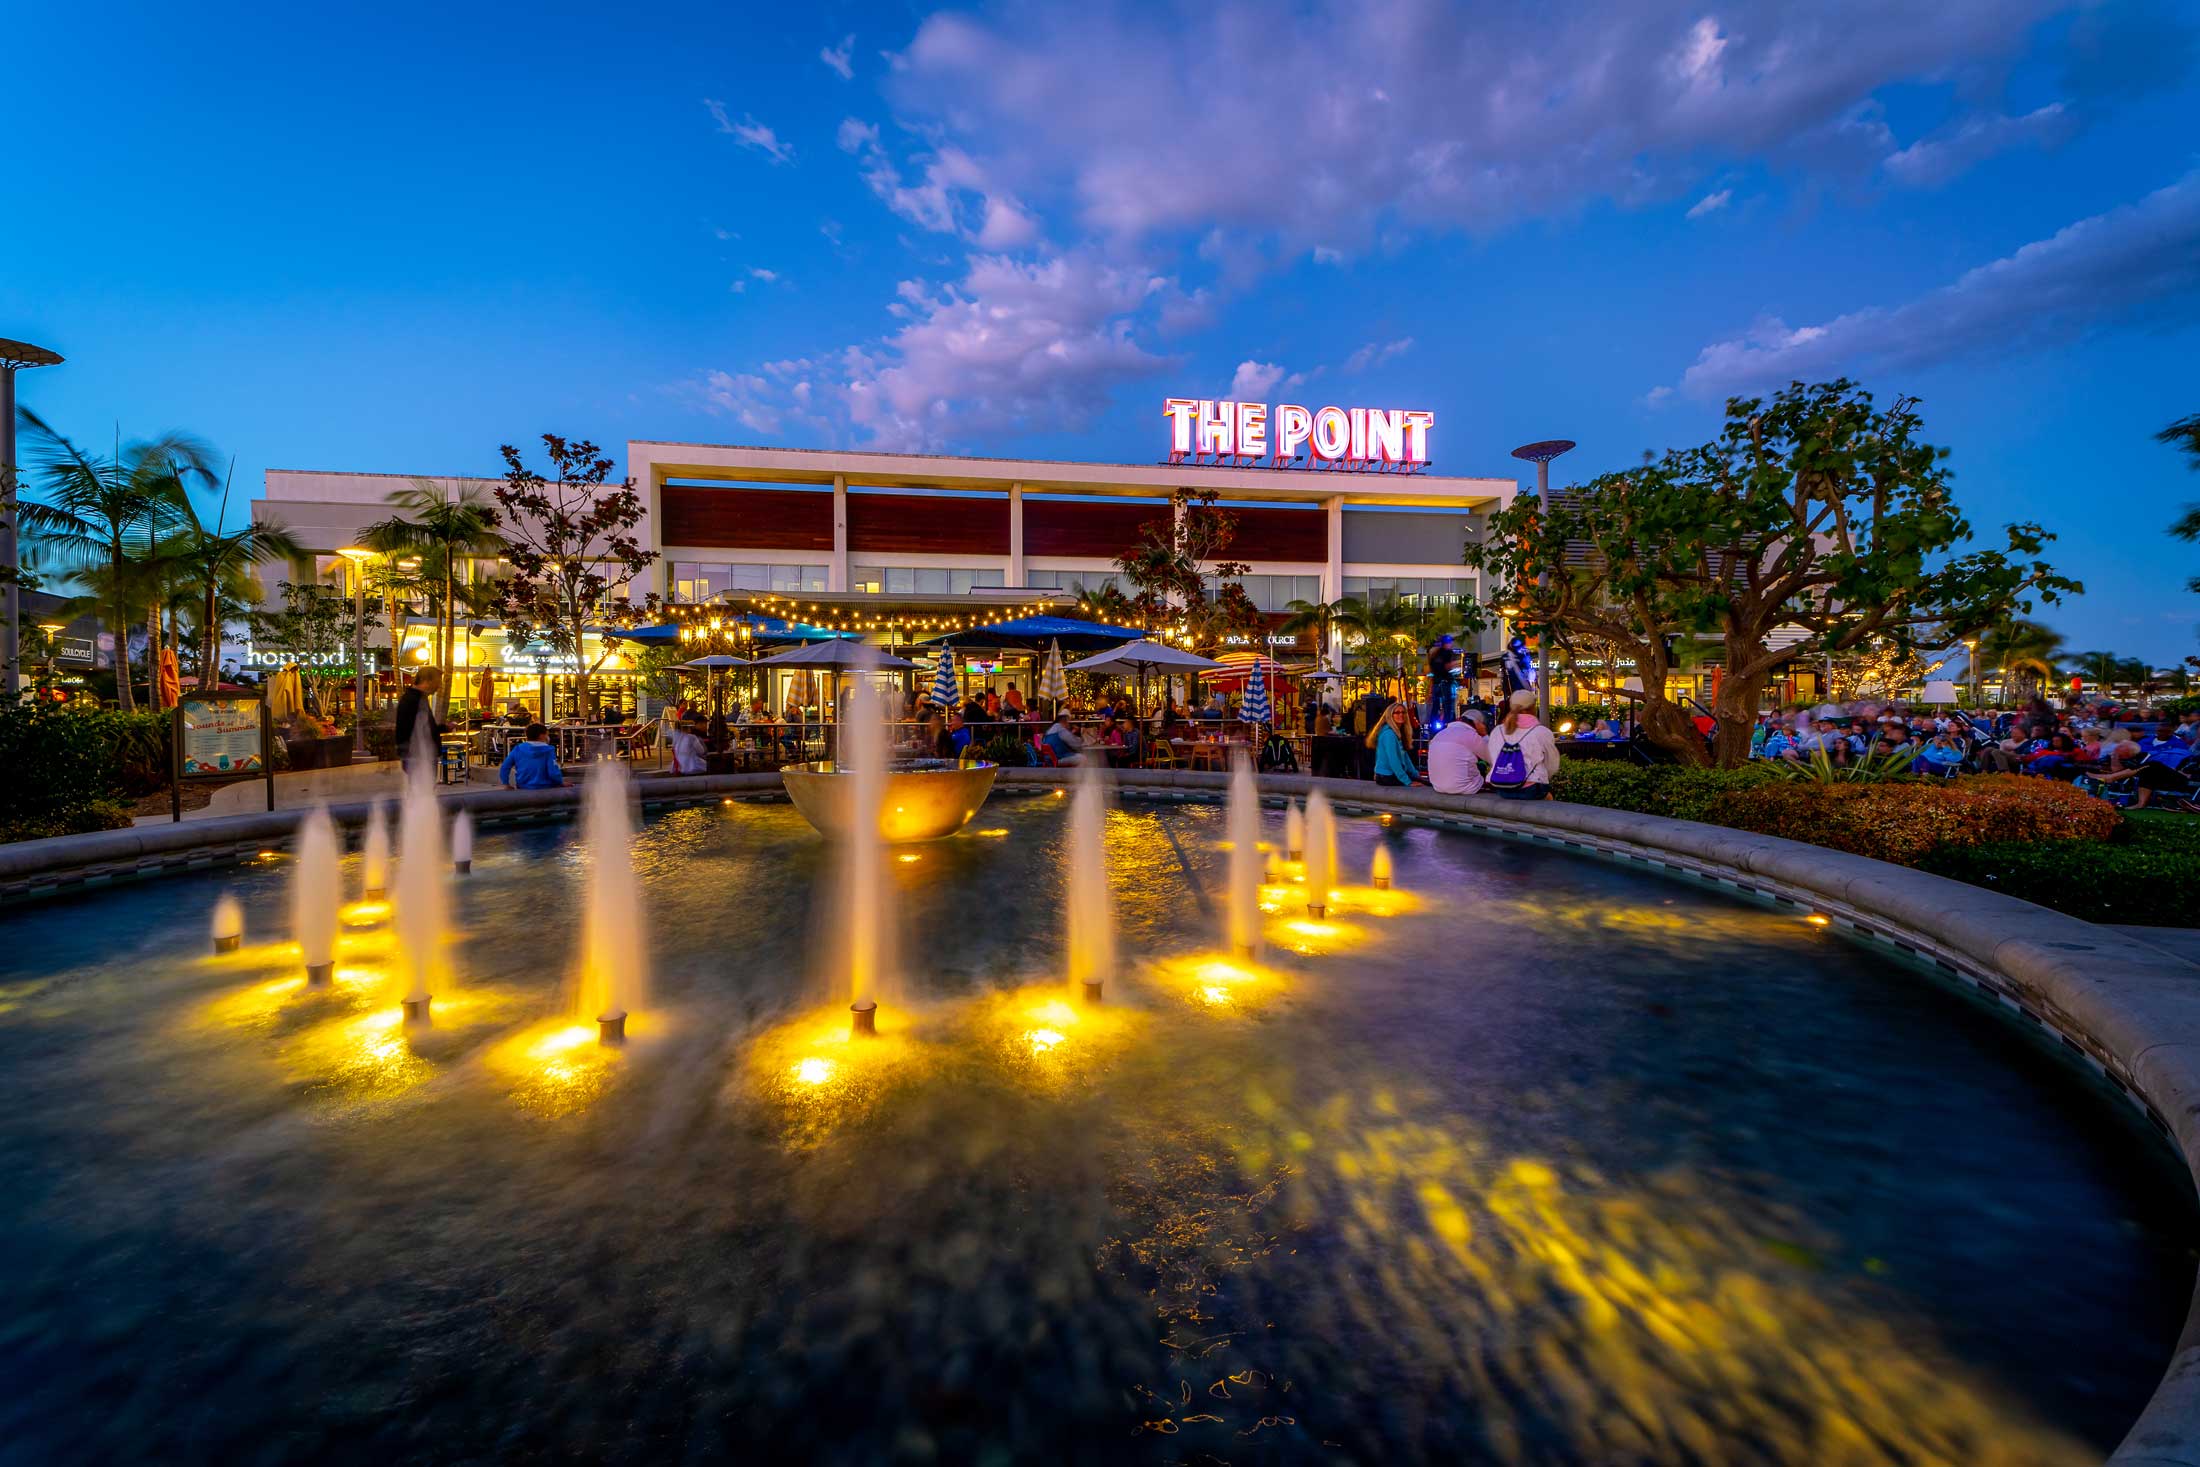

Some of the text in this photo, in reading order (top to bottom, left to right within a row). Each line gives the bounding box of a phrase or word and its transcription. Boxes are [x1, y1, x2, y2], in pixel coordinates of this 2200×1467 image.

[1163, 398, 1434, 462] THE POINT
[1265, 635, 1296, 645] OURCE
[60, 647, 92, 659] SOULCYCLE
[247, 641, 376, 675] hopody
[1529, 659, 1560, 669] juiry
[216, 723, 257, 734] Summer
